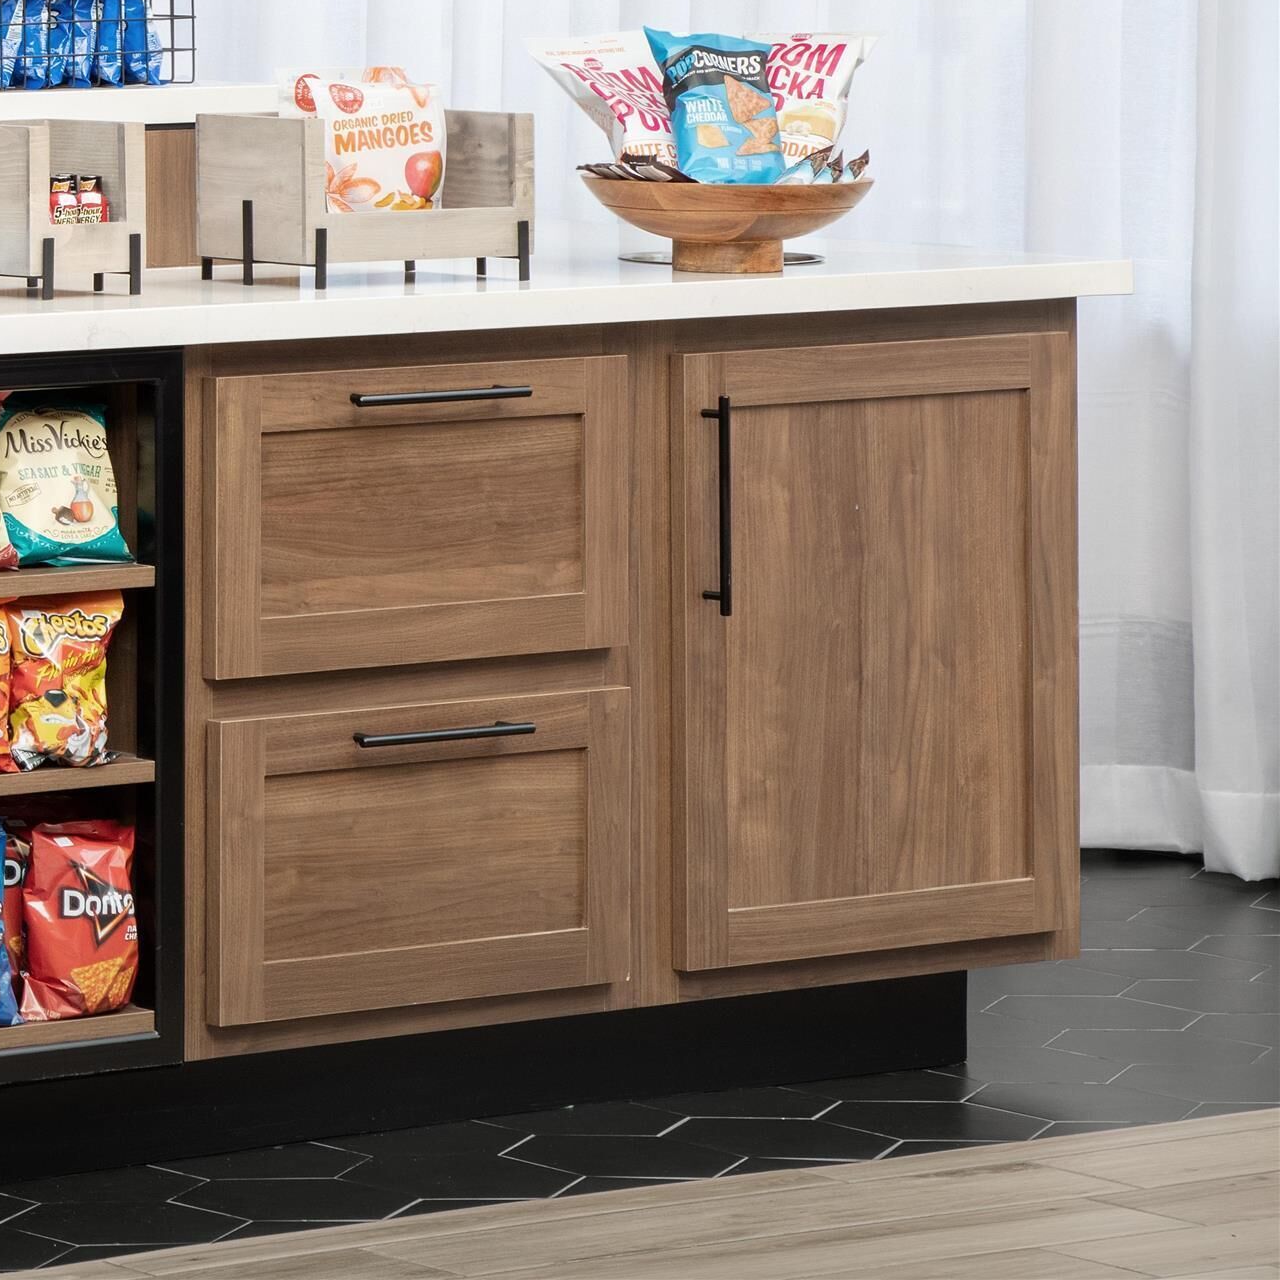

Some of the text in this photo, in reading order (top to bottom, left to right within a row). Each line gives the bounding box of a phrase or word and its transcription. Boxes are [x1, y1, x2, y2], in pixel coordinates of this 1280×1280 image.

[685, 99, 724, 112] WHITE
[333, 111, 413, 131] ORGANIC DRIED
[687, 112, 727, 123] CHEDDAR
[334, 120, 433, 155] MANGOES
[5, 420, 110, 459] Miss Vickie's
[18, 468, 37, 480] SEA
[38, 466, 59, 478] SALT
[62, 465, 70, 476] &
[21, 610, 110, 657] Cheetos
